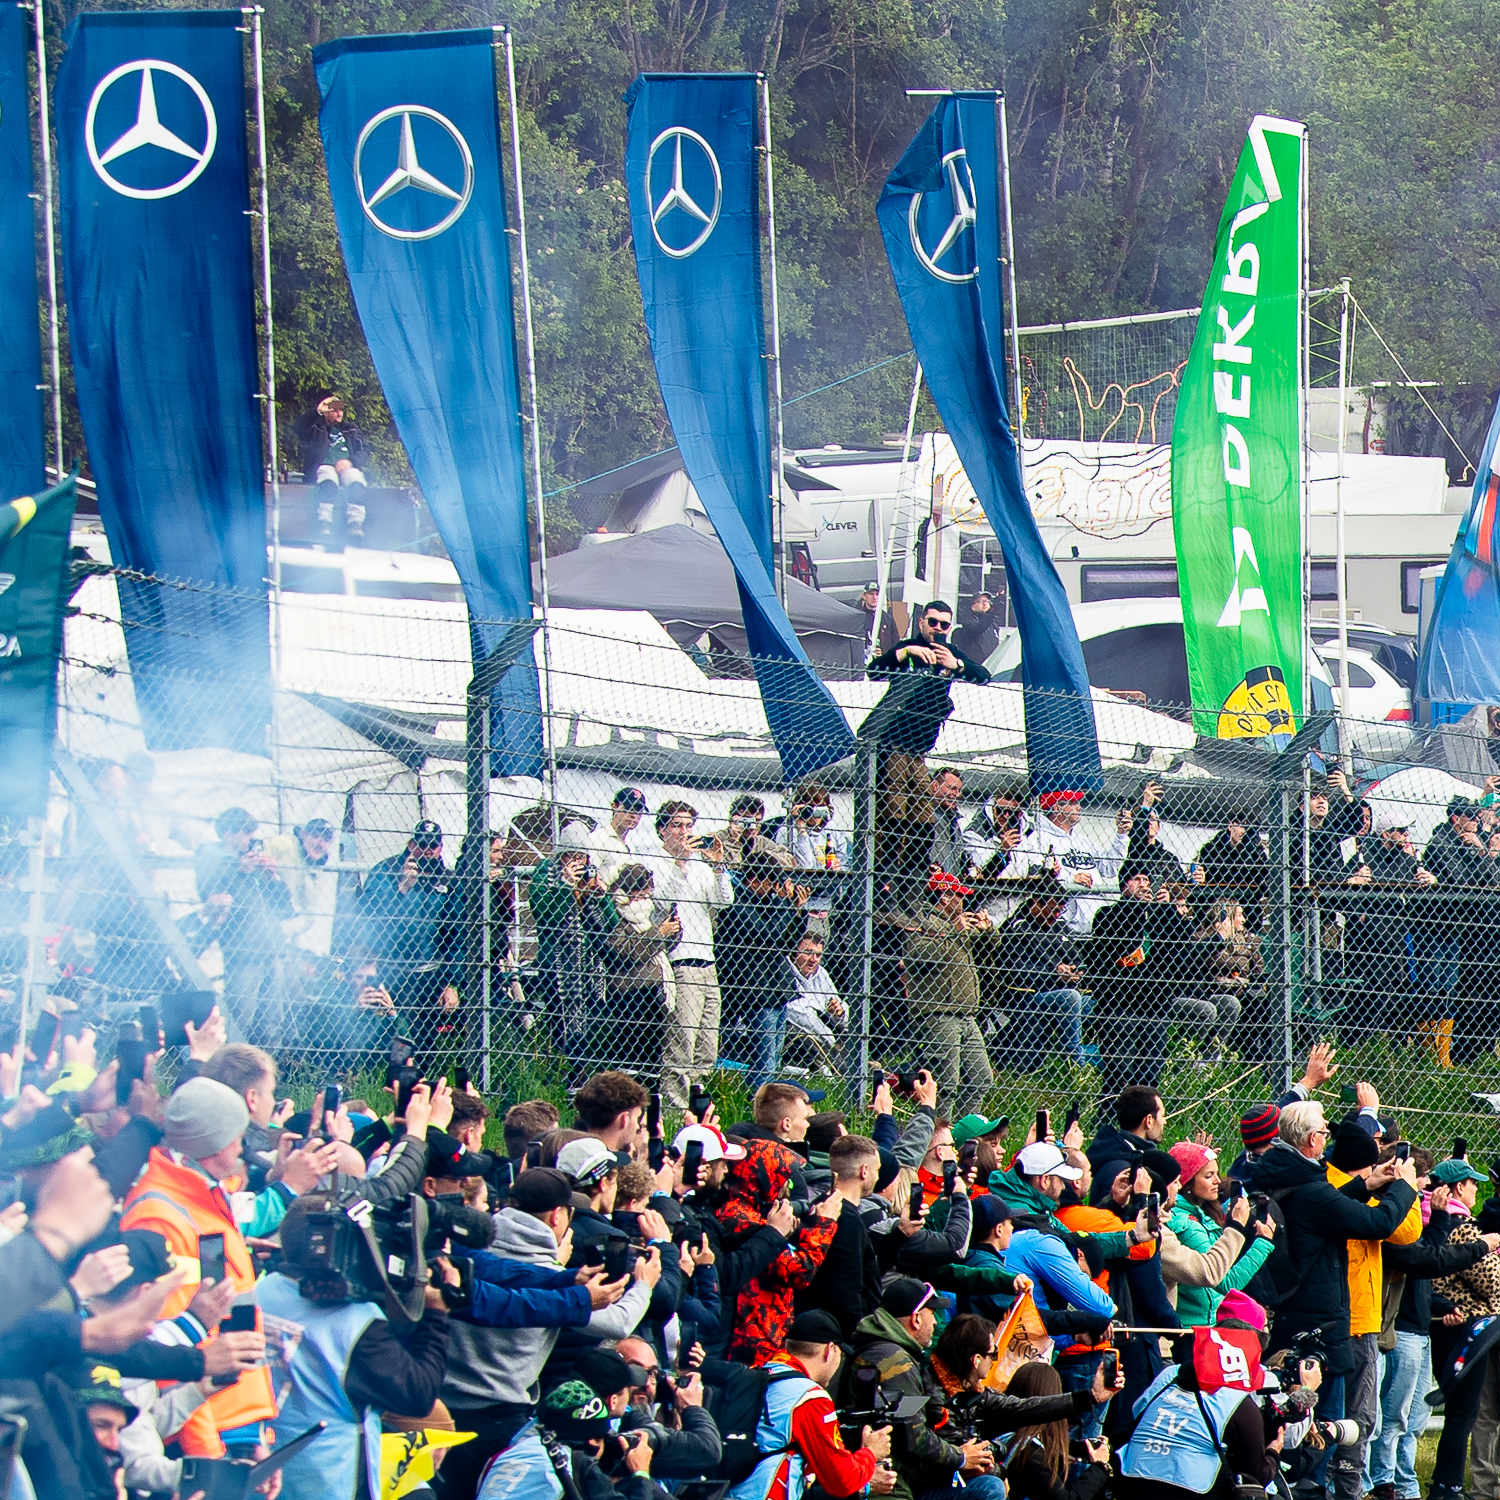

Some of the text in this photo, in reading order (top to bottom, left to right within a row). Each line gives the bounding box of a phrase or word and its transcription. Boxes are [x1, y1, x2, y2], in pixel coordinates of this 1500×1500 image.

[825, 520, 858, 532] CLEVER
[1152, 1407, 1189, 1437] TV
[1142, 1437, 1172, 1456] 335
